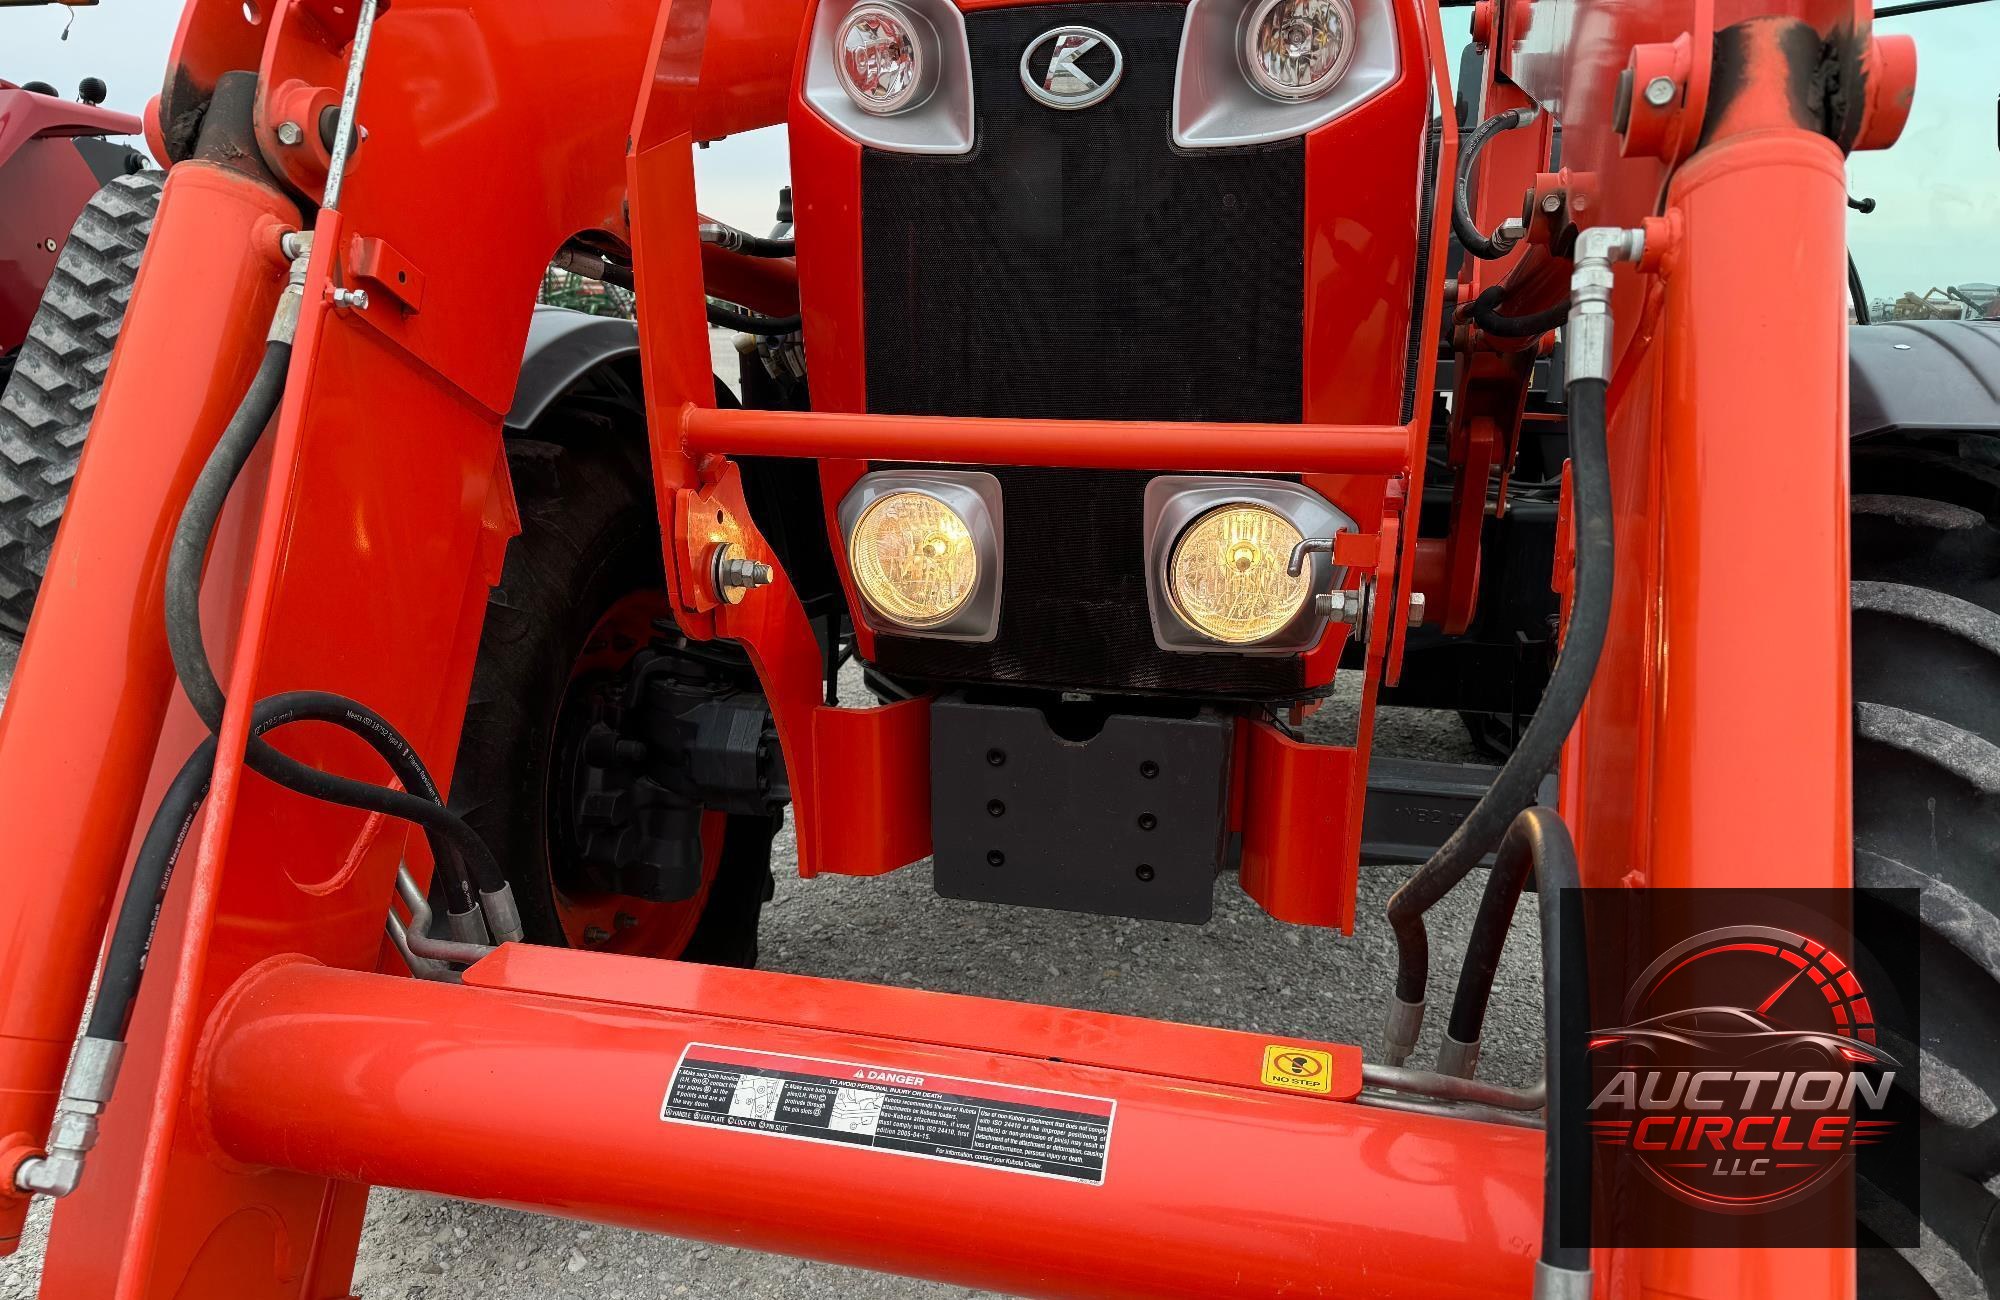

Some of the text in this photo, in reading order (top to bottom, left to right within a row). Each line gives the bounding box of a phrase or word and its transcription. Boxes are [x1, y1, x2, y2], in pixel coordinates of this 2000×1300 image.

[867, 1070, 924, 1086] DANGER
[857, 1083, 888, 1092] PERSONAL
[807, 1101, 825, 1109] through
[882, 1104, 911, 1113] attachments
[920, 1109, 937, 1117] Kubota
[938, 1111, 958, 1120] loaders.
[902, 1099, 933, 1109] recommends
[959, 1107, 976, 1115] Kubota
[775, 1124, 788, 1132] SLOT
[893, 1121, 912, 1130] comply
[1026, 1116, 1054, 1126] attachment
[1088, 1126, 1107, 1135] comply
[977, 1125, 1000, 1135] handle(s)
[1009, 1130, 1046, 1140] non-protrusion
[1054, 1136, 1070, 1144] pin(s)
[1083, 1140, 1098, 1149] result
[1041, 1127, 1066, 1136] improper
[1068, 1131, 1097, 1141] positioning
[976, 1133, 1003, 1142] detachment
[1018, 1139, 1045, 1148] attachment
[1084, 1150, 1104, 1158] causing
[992, 1144, 1023, 1155] performance,
[1025, 1149, 1046, 1158] personal
[1047, 1152, 1061, 1160] injury
[946, 1148, 973, 1159] information,
[1006, 1158, 1024, 1166] Kubota
